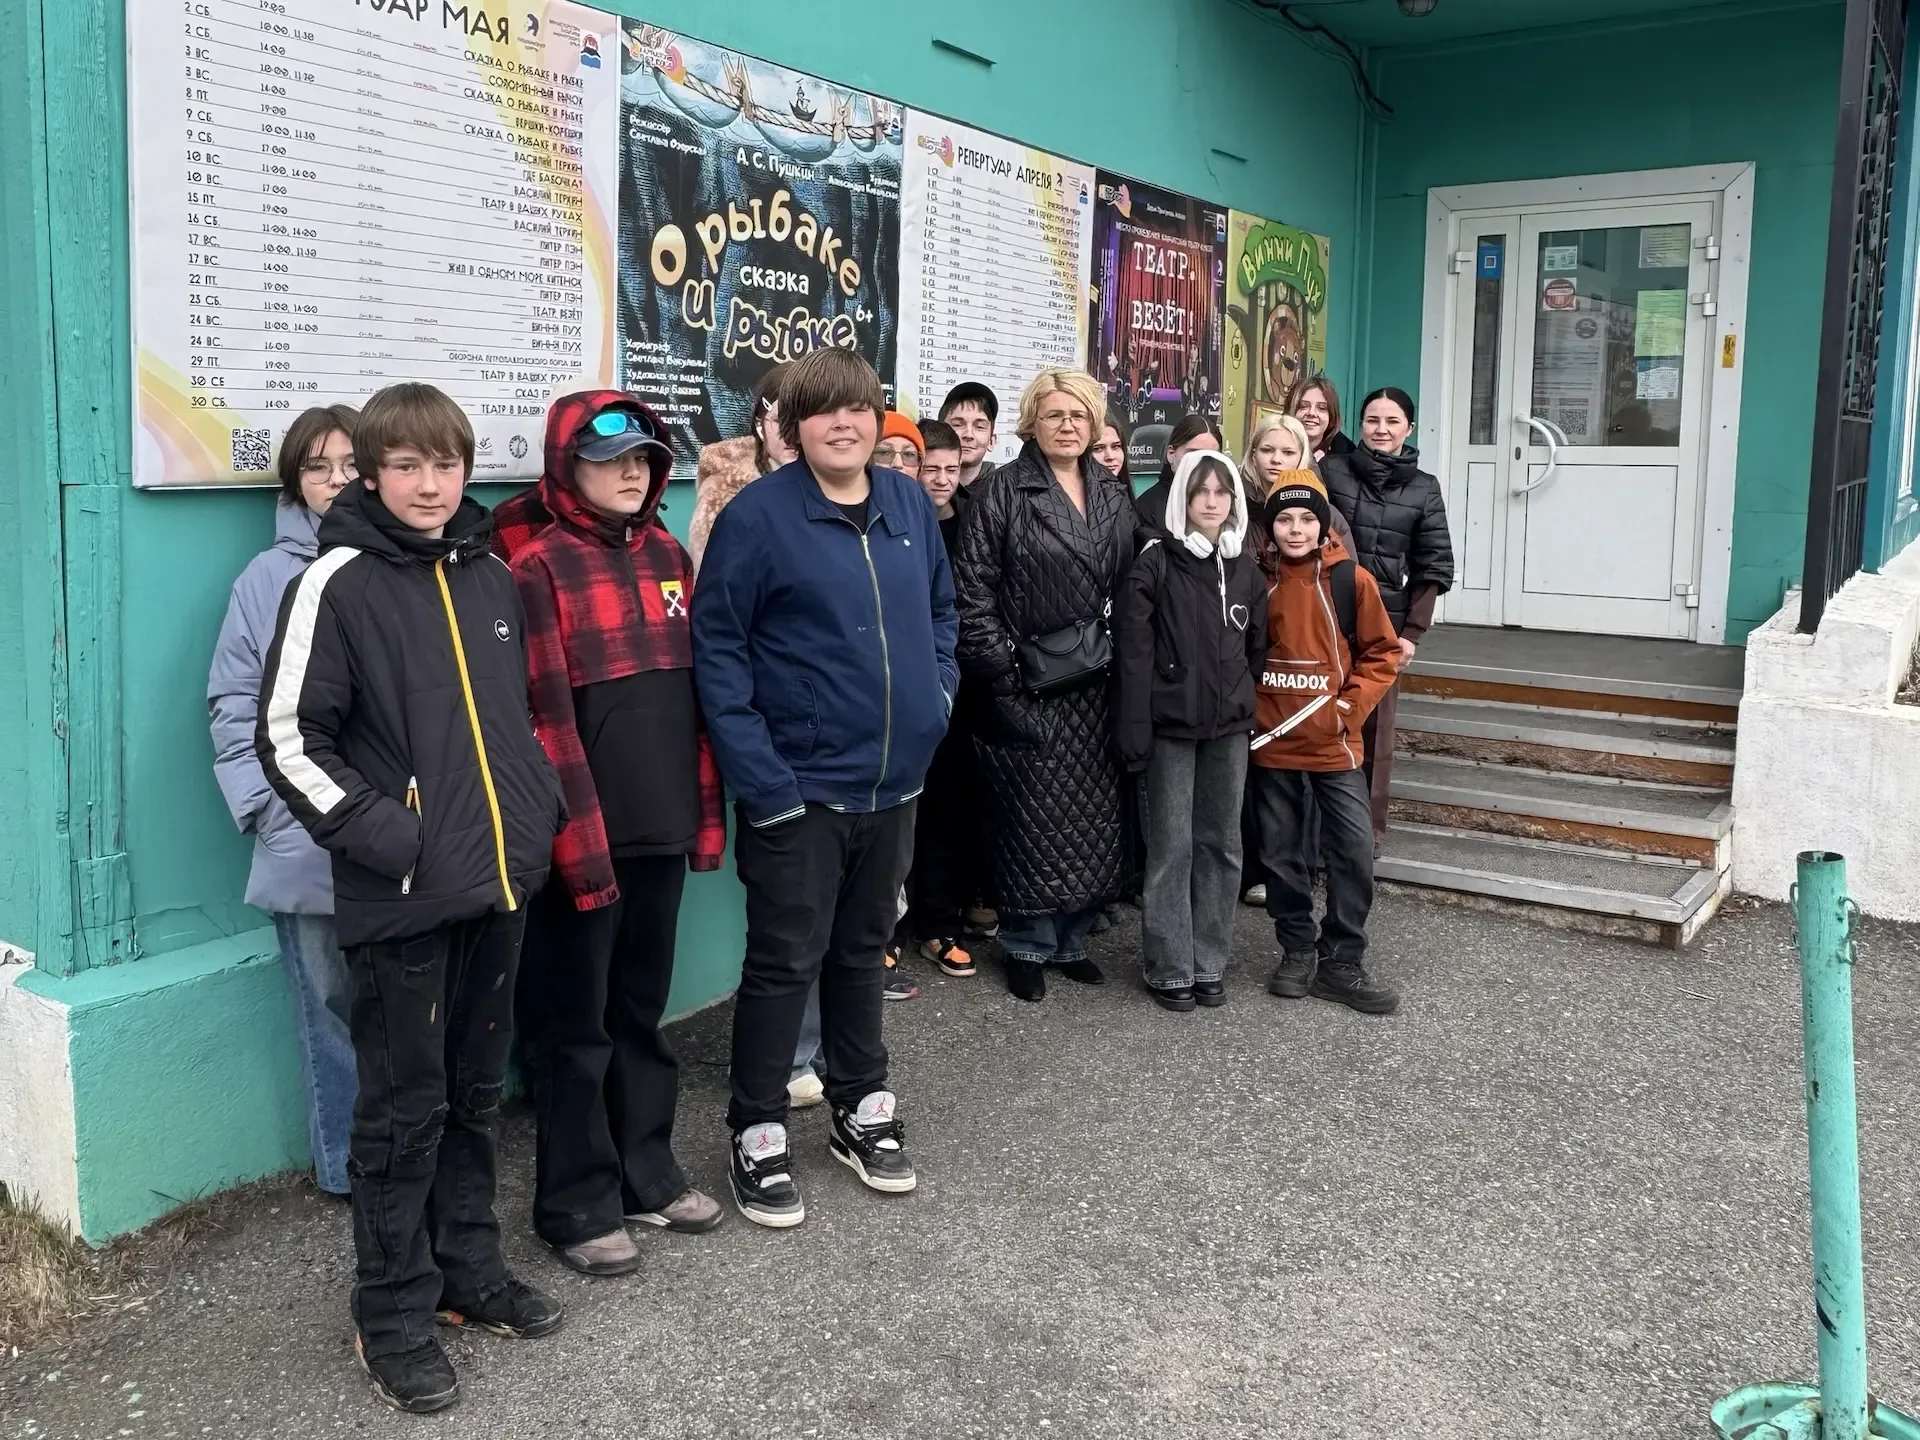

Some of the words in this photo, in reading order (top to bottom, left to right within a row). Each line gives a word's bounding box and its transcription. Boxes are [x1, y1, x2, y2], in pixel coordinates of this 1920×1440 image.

[185, 2, 191, 12] 2
[442, 0, 509, 45] МАЯ
[185, 24, 191, 34] 2
[185, 46, 191, 56] 3
[464, 50, 503, 70] СКАЗКА
[507, 60, 515, 70] О
[186, 66, 191, 77] 3
[464, 87, 502, 106] СКАЗКА
[507, 98, 515, 108] О
[186, 130, 192, 140] 9
[464, 124, 503, 140] СКАЗКА
[507, 133, 514, 142] О
[187, 150, 201, 162] 10
[736, 147, 749, 166] А.
[752, 152, 766, 170] С.
[768, 155, 815, 181] Пушкин
[958, 146, 1012, 177] РЕПЕРТУАР
[1016, 166, 1052, 190] АПРЕЛЯ
[187, 171, 201, 182] 10
[481, 197, 506, 210] ТЕАТР
[188, 213, 199, 223] 16
[695, 189, 862, 297] рыбаке
[188, 253, 199, 264] 17
[1133, 241, 1195, 281] ТЕАТР.
[478, 266, 515, 280] ОДНОМ
[739, 264, 809, 296] сказка
[189, 294, 200, 304] 23
[190, 314, 201, 324] 24
[855, 305, 874, 323] 6+
[682, 279, 717, 331] и
[722, 296, 857, 361] рыбке
[562, 325, 582, 336] ПУХ
[190, 336, 201, 346] 24
[562, 341, 582, 352] ПУХ
[190, 356, 203, 366] 29
[481, 370, 506, 380] ТЕАТР
[191, 397, 206, 406] 30
[481, 404, 506, 414] ТЕАТР
[1262, 671, 1329, 691] PARADOX
